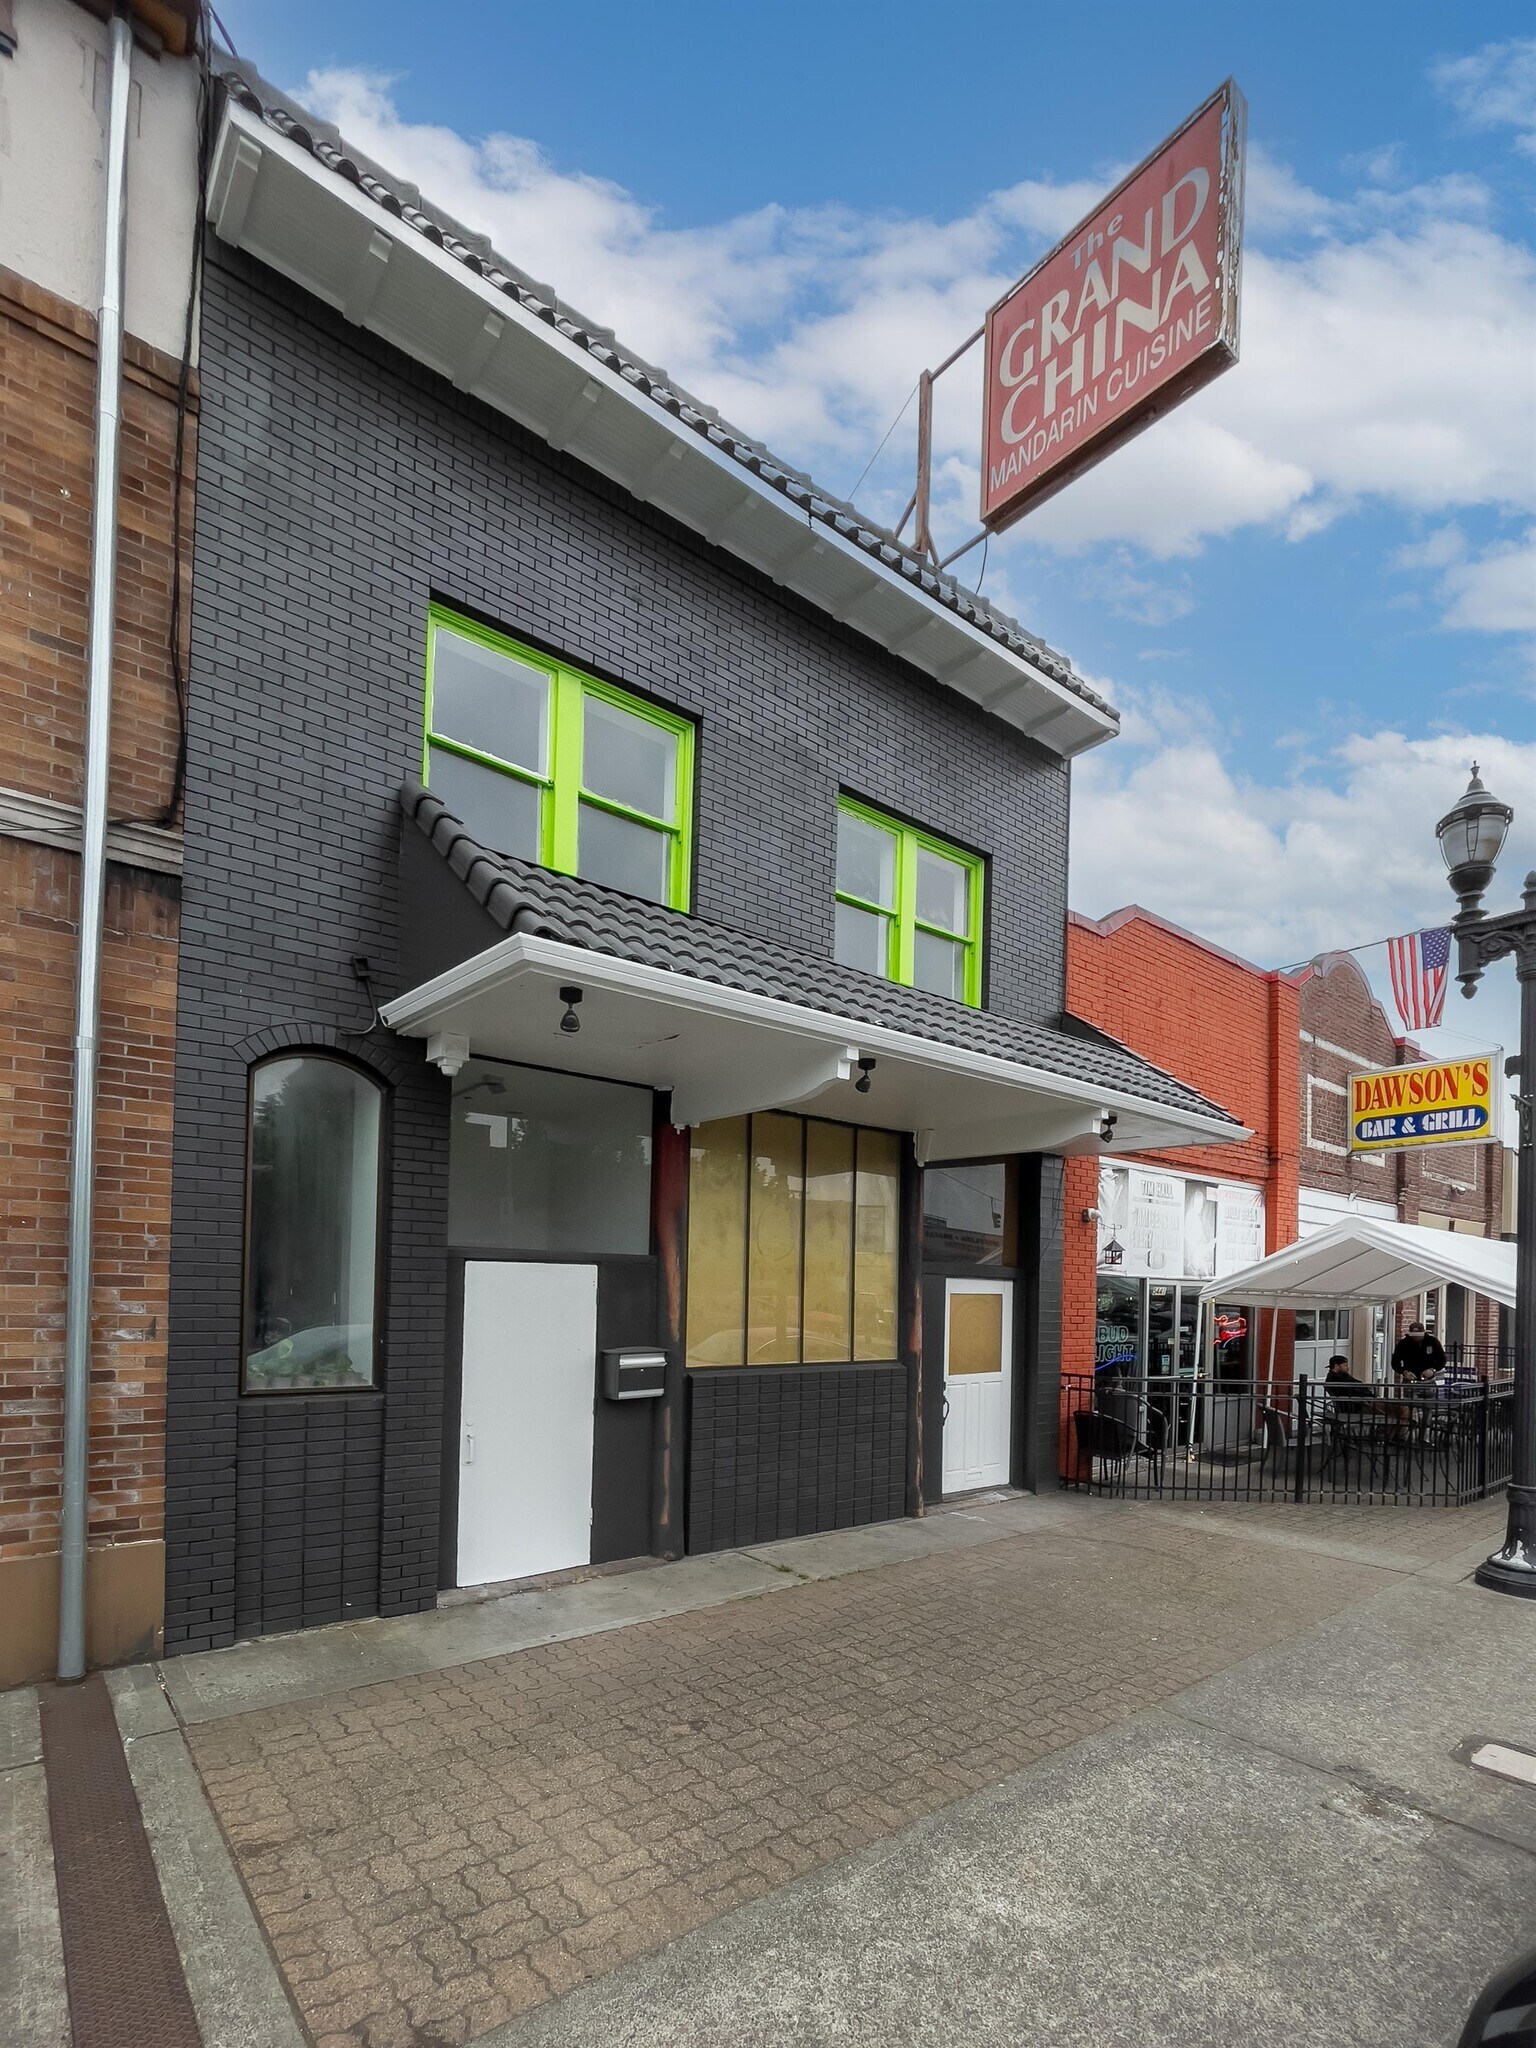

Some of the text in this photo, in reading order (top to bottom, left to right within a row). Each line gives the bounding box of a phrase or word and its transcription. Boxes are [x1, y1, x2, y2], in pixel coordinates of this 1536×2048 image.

[1070, 214, 1123, 270] The
[1000, 166, 1210, 388] GRAND
[1000, 239, 1210, 445] CHINA
[991, 292, 1212, 494] MANDARIN CUISINE
[1355, 1062, 1489, 1112] DAWSON'S
[1362, 1108, 1482, 1139] BAR & GRILL
[1140, 1179, 1174, 1200] TIM HALL
[1098, 1326, 1129, 1343] BUD
